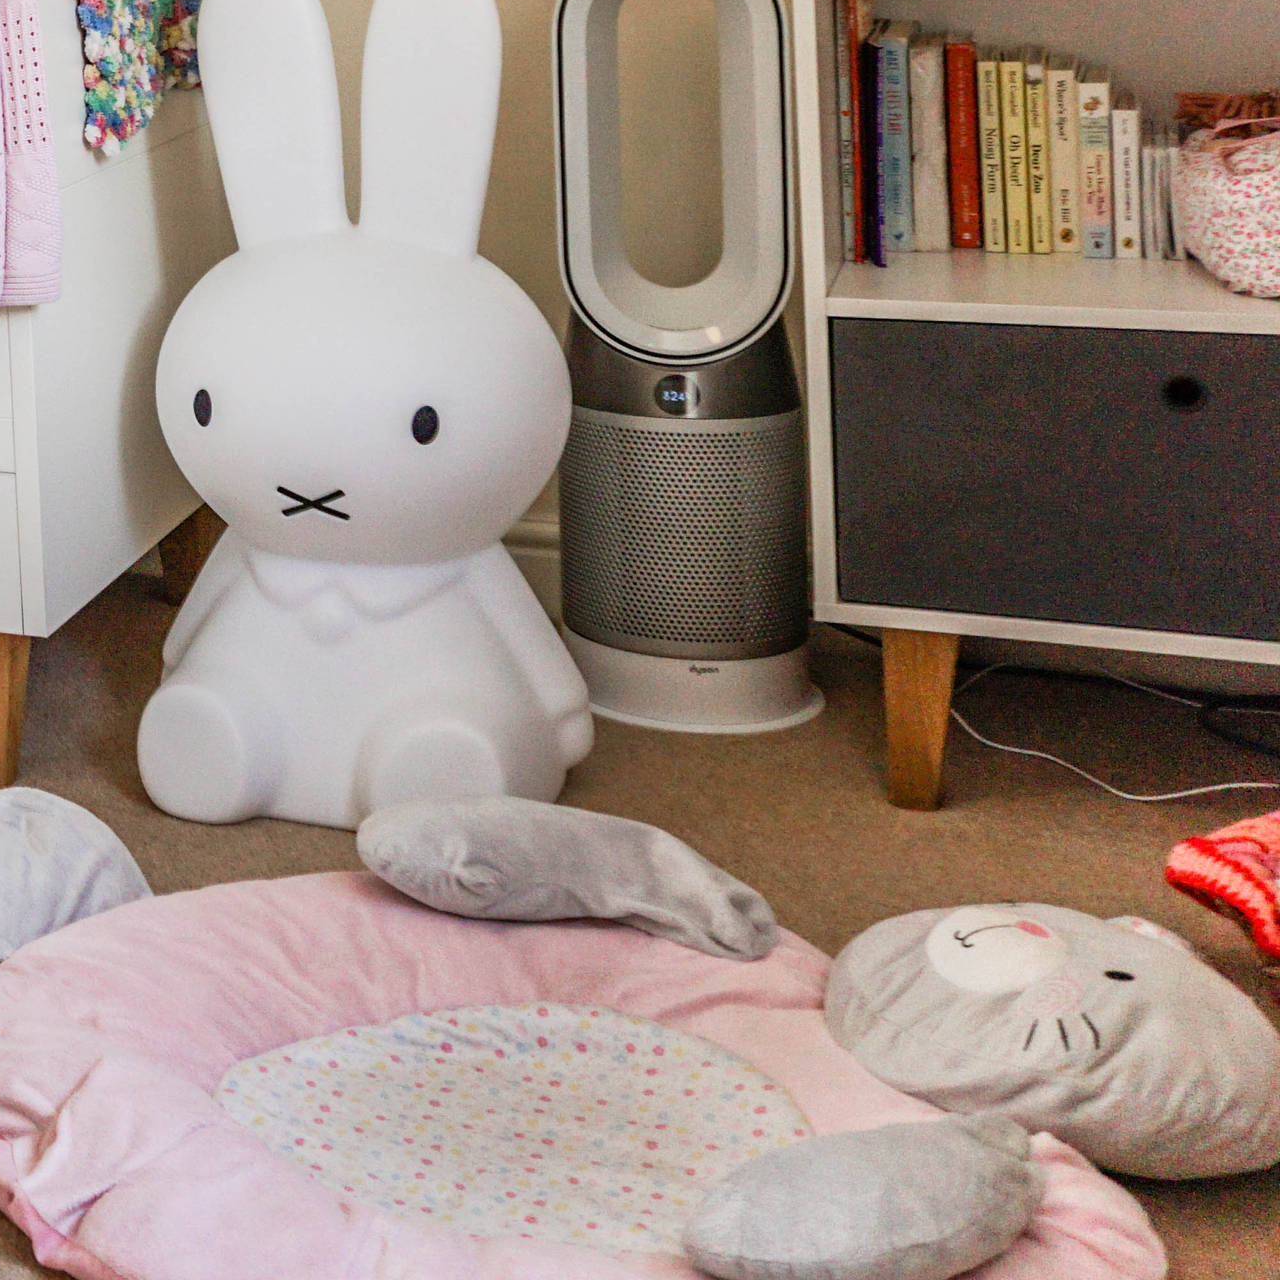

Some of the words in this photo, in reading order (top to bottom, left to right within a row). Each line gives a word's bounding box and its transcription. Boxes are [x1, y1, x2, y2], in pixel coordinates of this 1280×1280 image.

[984, 128, 998, 160] Noisy
[1009, 135, 1022, 152] Oh
[1032, 144, 1043, 171] Dear
[987, 164, 999, 194] Farm
[1009, 156, 1023, 187] Dear!
[1033, 175, 1044, 194] Zoo
